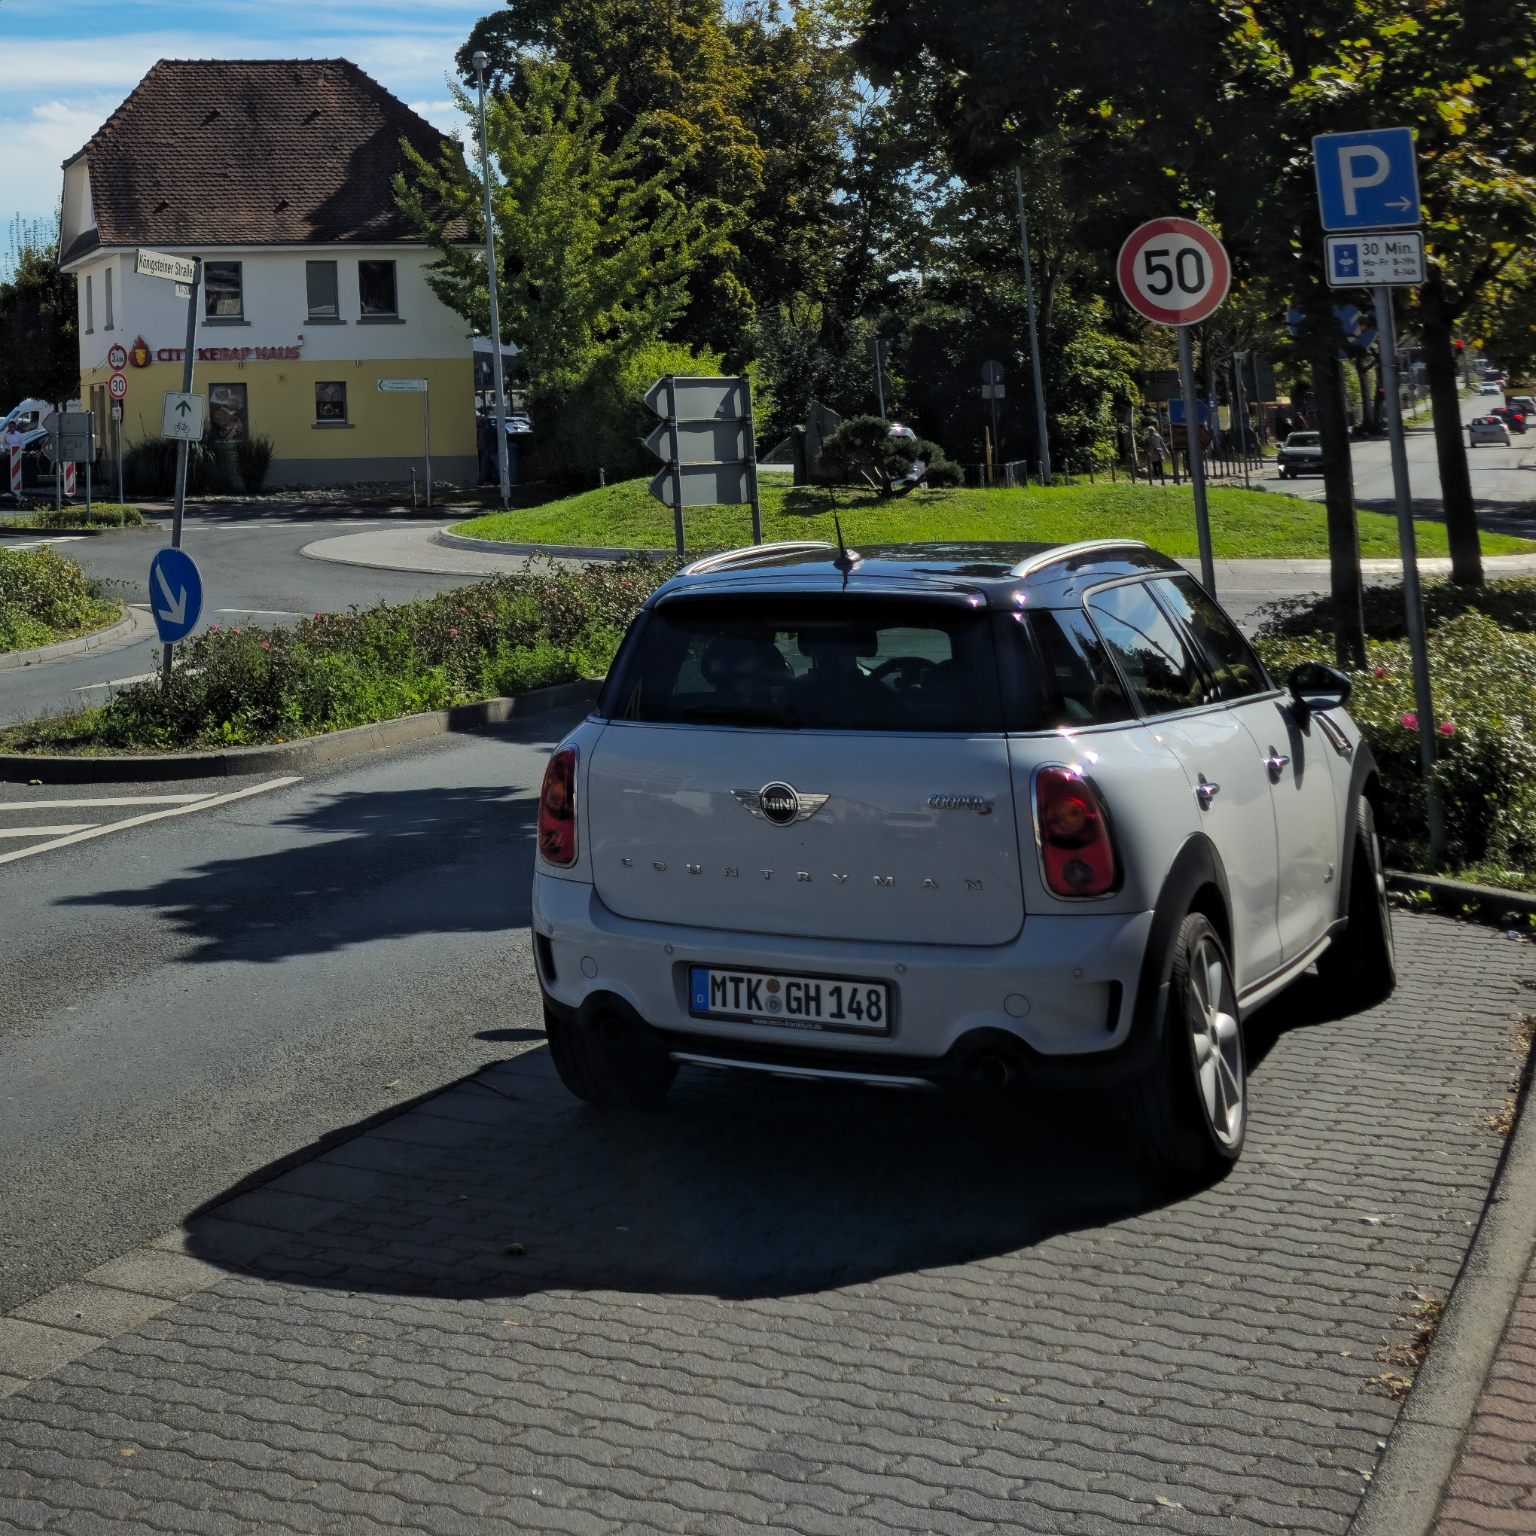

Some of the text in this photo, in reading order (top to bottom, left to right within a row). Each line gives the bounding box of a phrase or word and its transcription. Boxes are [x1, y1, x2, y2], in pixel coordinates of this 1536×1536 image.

[1337, 144, 1391, 216] P
[1362, 242, 1415, 256] 30 Min.
[138, 253, 193, 278] Königsteiner Straße
[1144, 247, 1206, 296] 50
[157, 346, 301, 362] CIT KEBAP HAUS
[112, 379, 124, 392] 30
[765, 798, 795, 811] MINI
[927, 794, 984, 811] COOPER
[620, 858, 984, 892] COUNTRYMAN
[710, 974, 883, 1023] MTK GH 148
[752, 1017, 823, 1031] www.mini-frankfurt.de
